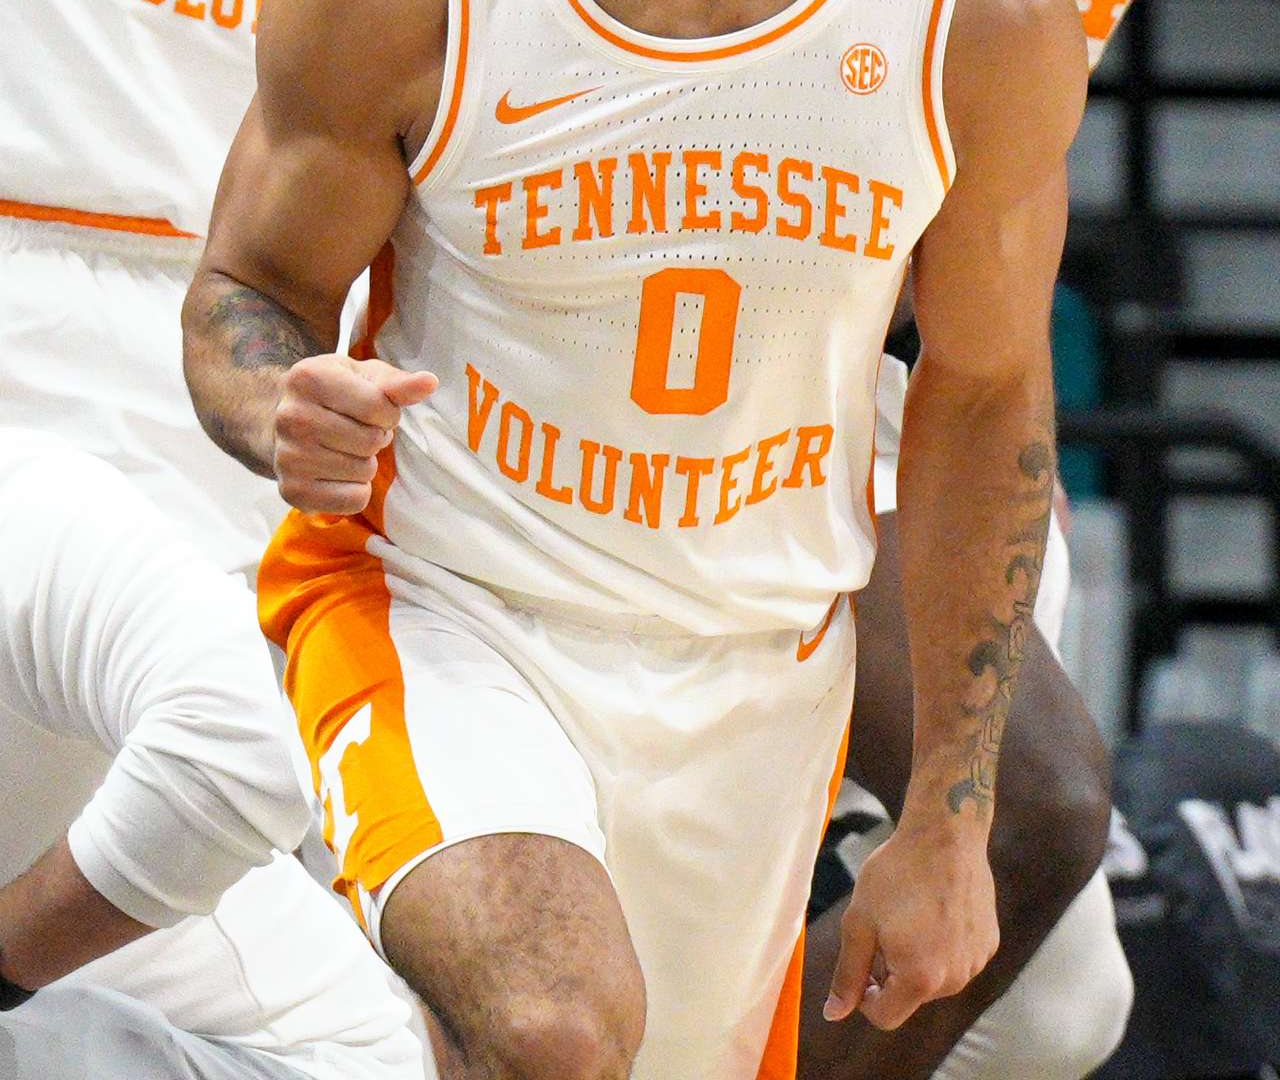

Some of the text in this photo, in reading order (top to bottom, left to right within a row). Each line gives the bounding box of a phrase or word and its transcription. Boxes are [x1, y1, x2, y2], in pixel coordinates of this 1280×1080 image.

[845, 47, 883, 90] SEC
[474, 150, 904, 260] TENNESSEE
[630, 267, 742, 416] 0
[465, 362, 834, 529] VOLUNTEER
